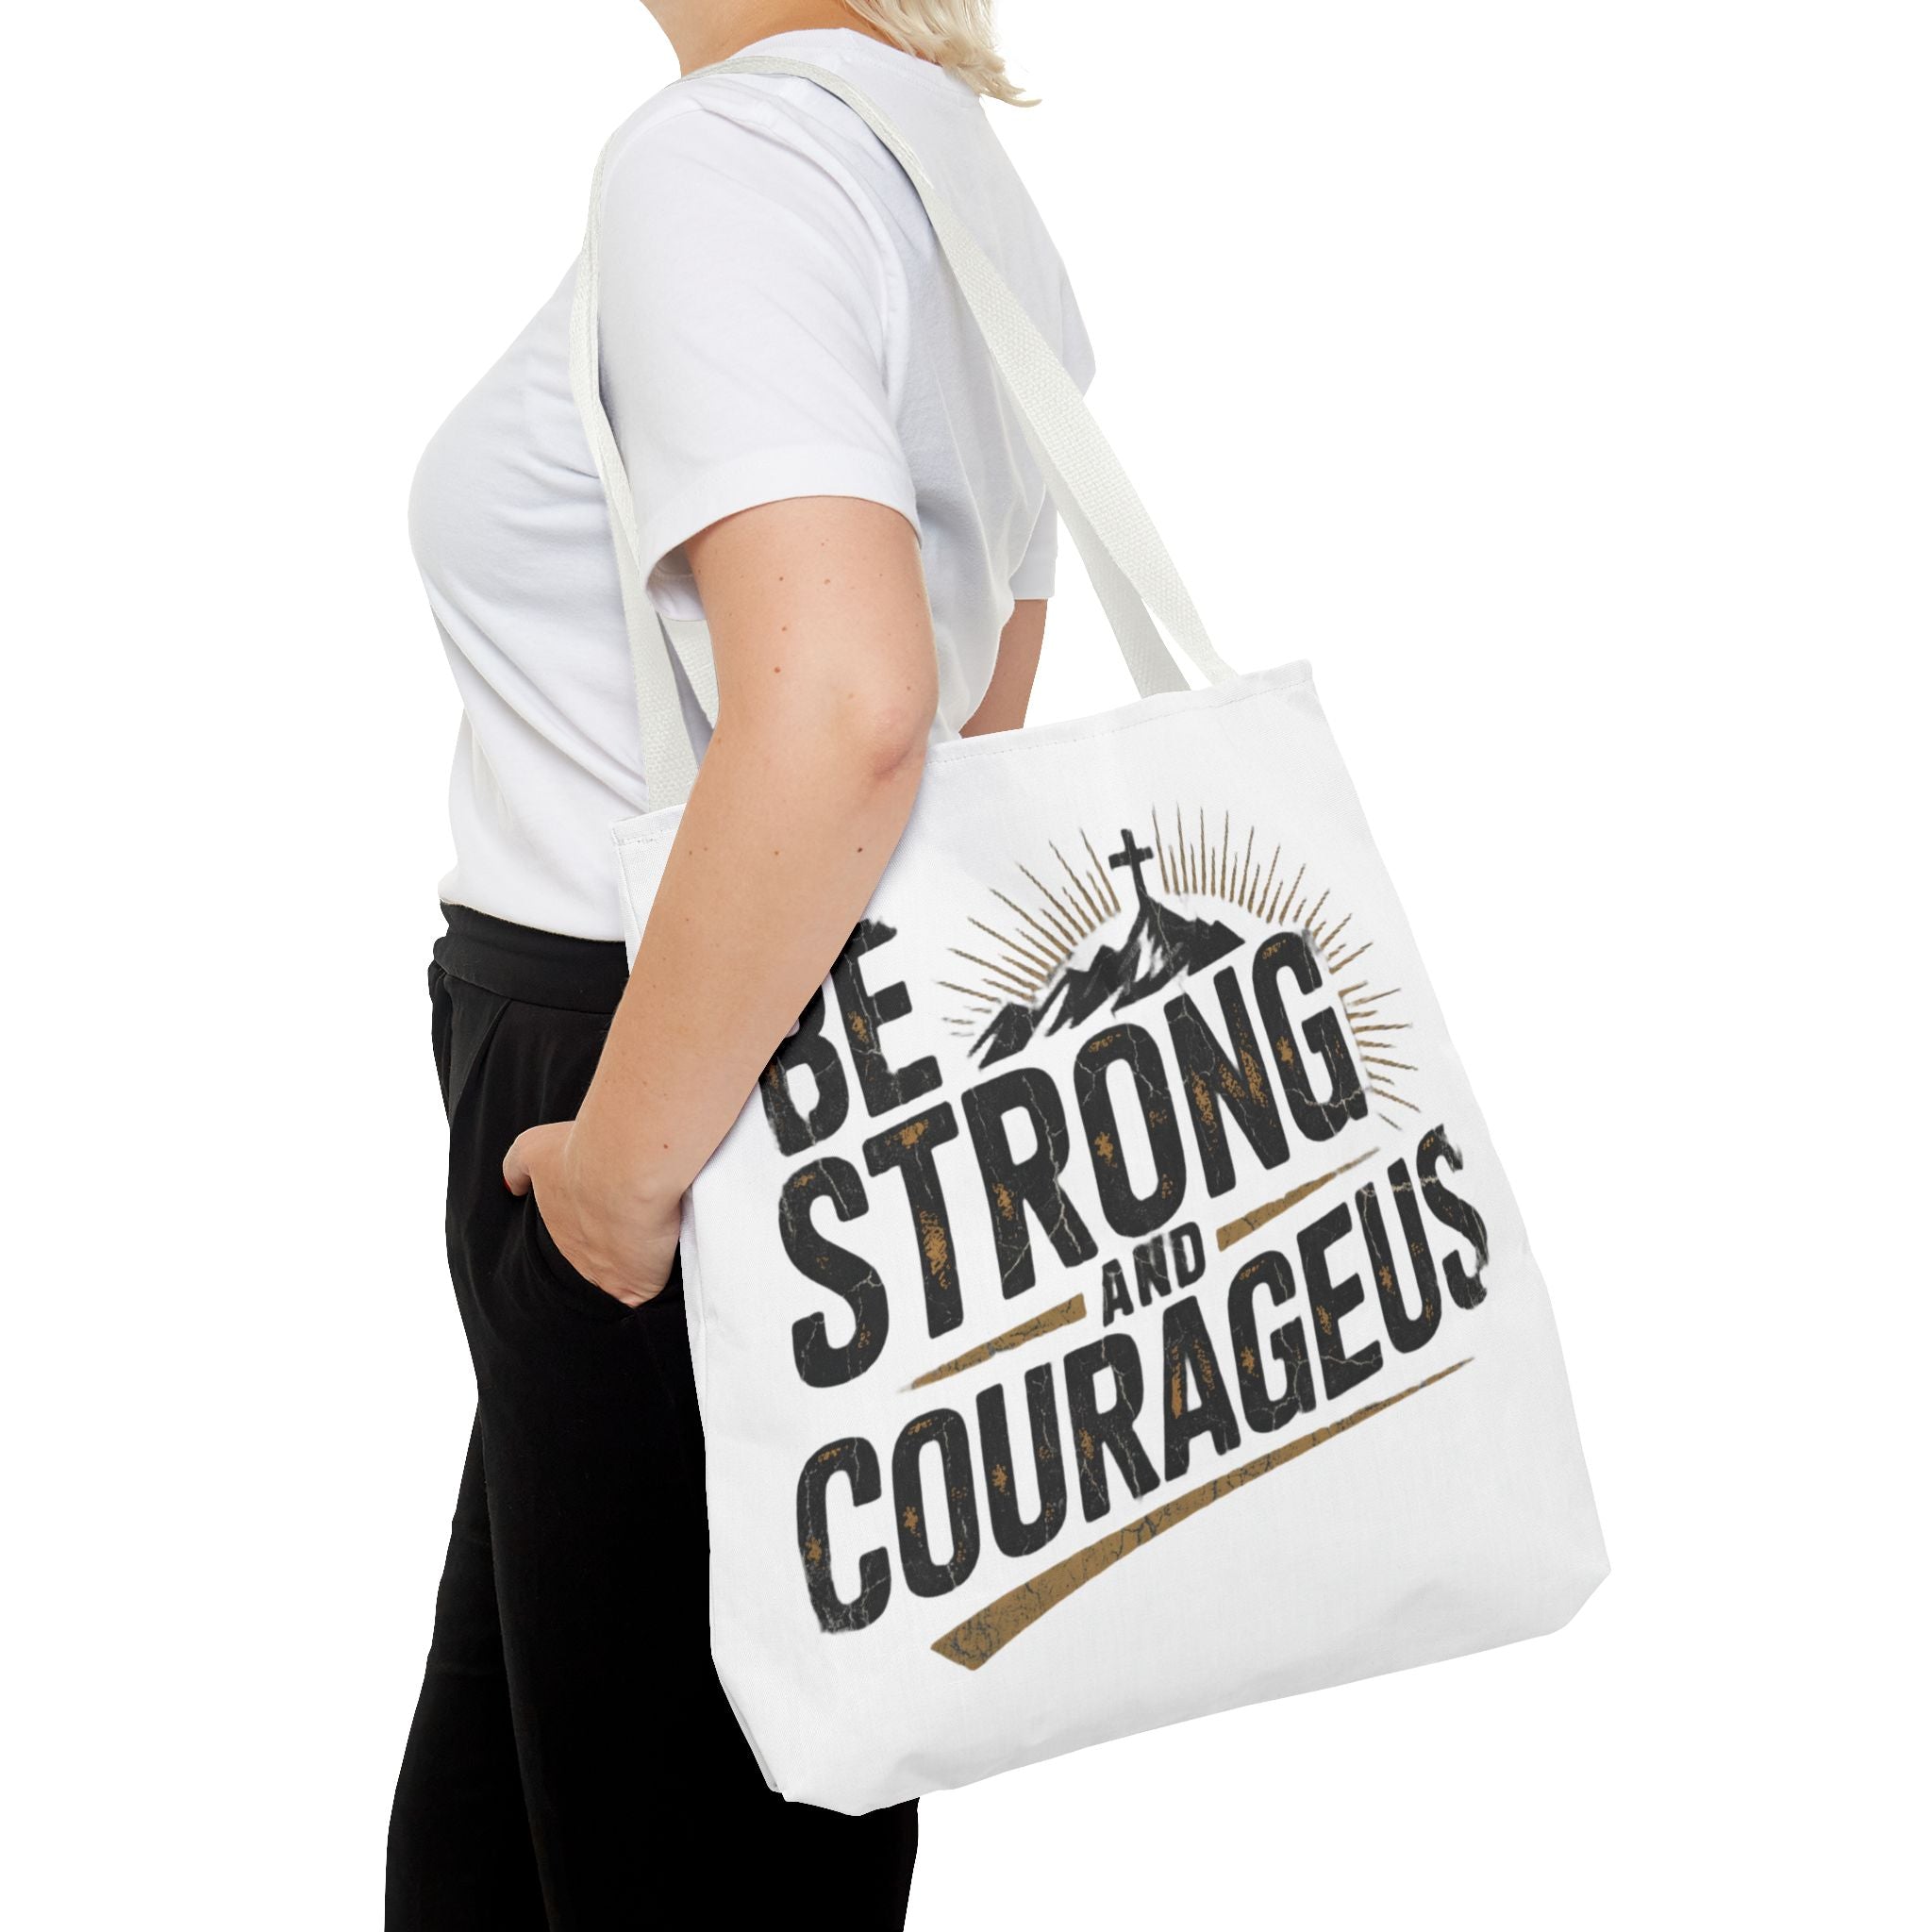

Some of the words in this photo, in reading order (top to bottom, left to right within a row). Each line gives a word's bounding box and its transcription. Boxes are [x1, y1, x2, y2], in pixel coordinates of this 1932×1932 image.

[758, 918, 943, 1157] BE
[778, 931, 1370, 1389] STRONG
[796, 1124, 1490, 1635] COURAGEUS
[1102, 1222, 1206, 1327] AND
